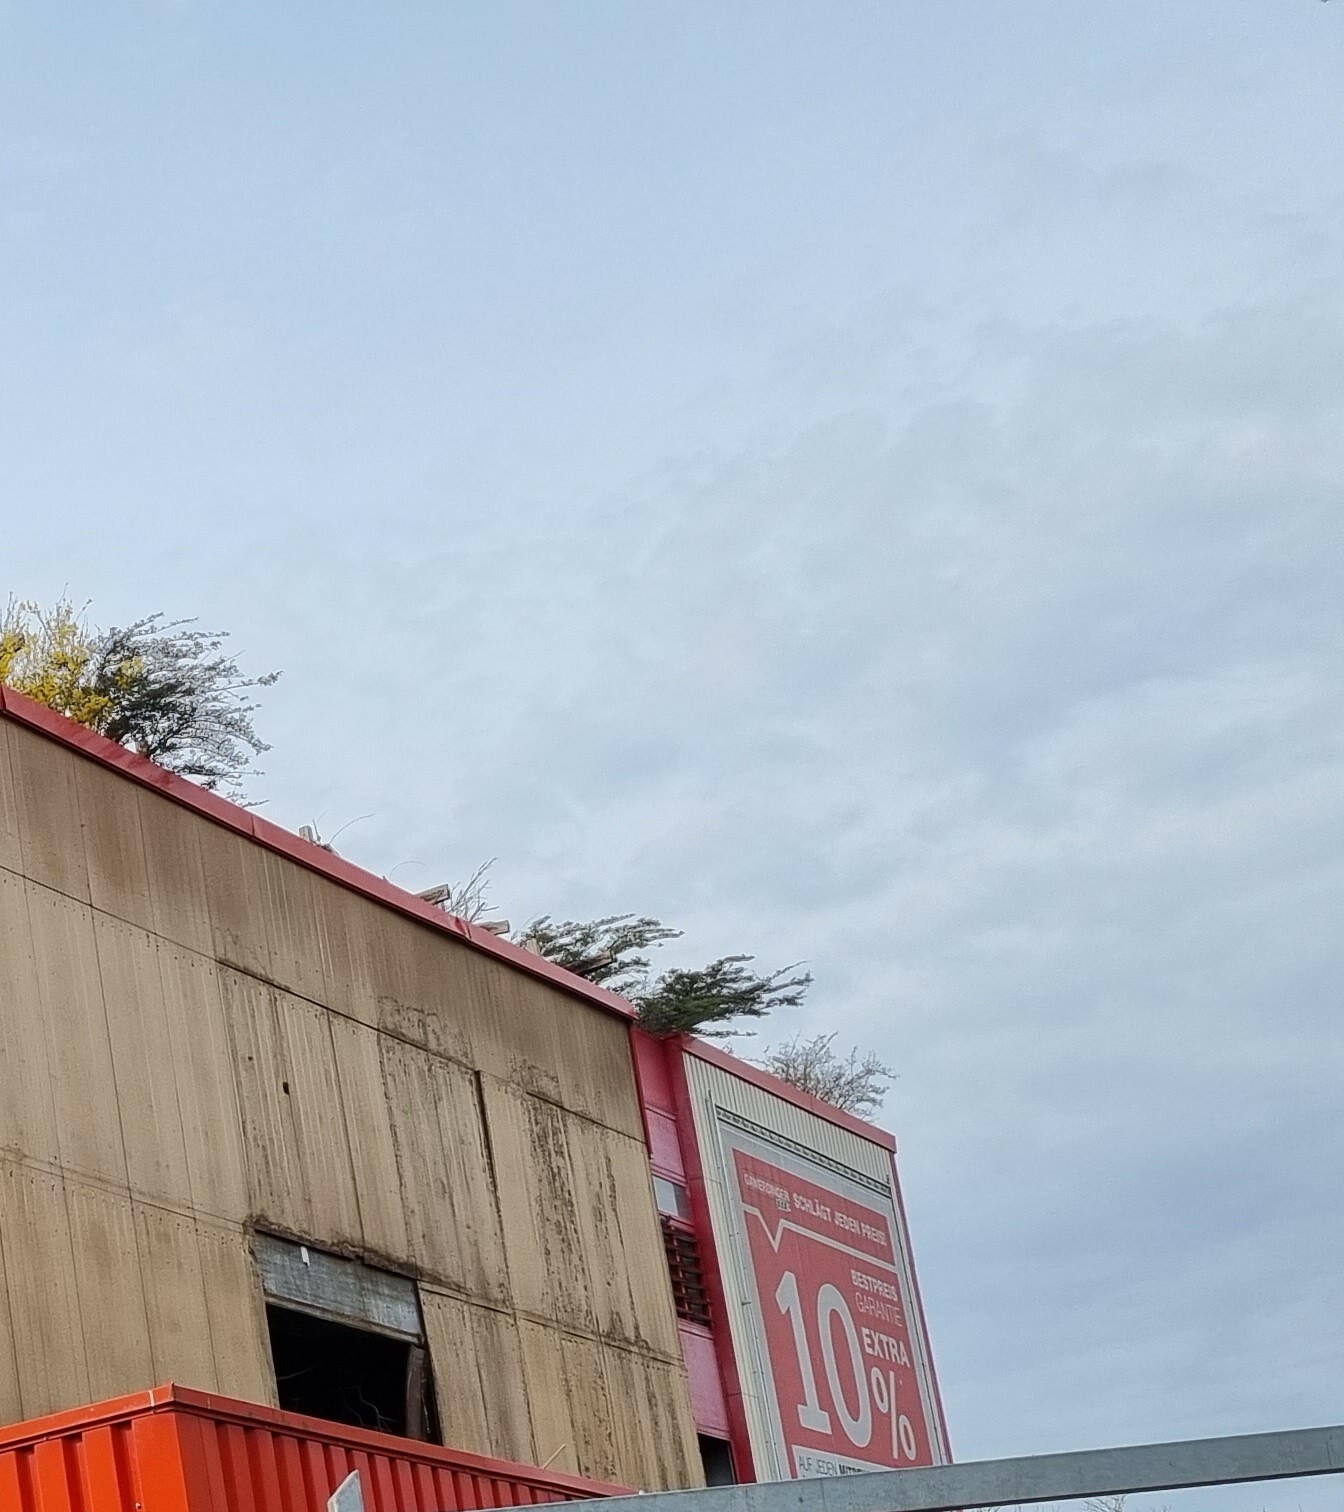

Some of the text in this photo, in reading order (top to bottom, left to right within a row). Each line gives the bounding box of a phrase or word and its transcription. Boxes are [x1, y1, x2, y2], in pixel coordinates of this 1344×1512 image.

[793, 1192, 832, 1220] SCHLÄGT
[834, 1211, 861, 1235] JEDEN
[851, 1269, 899, 1301] BESTPREIS
[855, 1292, 903, 1327] GARANTIE
[862, 1327, 911, 1368] EXTRA
